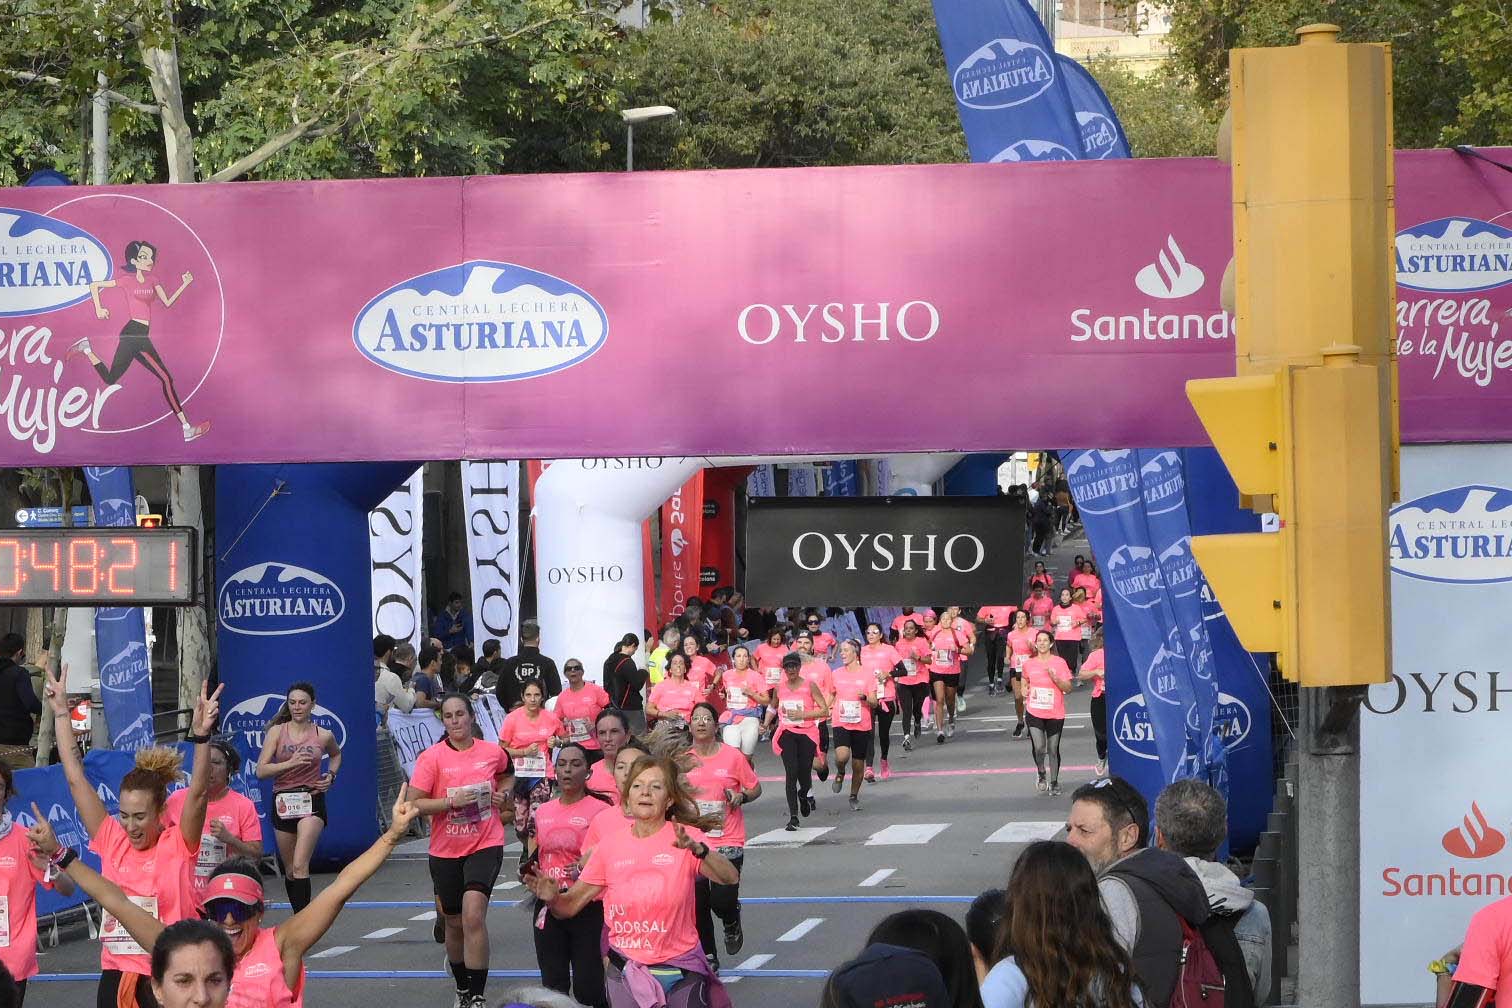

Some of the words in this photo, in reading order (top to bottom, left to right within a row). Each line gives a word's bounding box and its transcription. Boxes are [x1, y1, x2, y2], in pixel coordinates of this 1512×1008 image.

[15, 243, 87, 256] LECHERA
[1410, 242, 1460, 251] CENTRAL
[1466, 241, 1512, 250] LECHER
[412, 303, 489, 317] CENTRAL
[498, 301, 580, 314] LECHERA
[1396, 298, 1492, 328] arrera
[372, 308, 588, 353] ASTURIANA
[737, 300, 941, 345] OYSHO
[1071, 308, 1237, 342] Santand
[1419, 328, 1437, 356] la
[1433, 321, 1512, 388] Muje
[1417, 520, 1487, 531] CENTRAL
[791, 531, 985, 573] OYSHO
[548, 565, 624, 586] OYSHO
[235, 587, 277, 595] CENTRAL
[282, 586, 331, 595] LECHERA
[223, 590, 335, 619] ASTURIANA
[521, 667, 536, 677] BP
[445, 824, 478, 835] SUMA
[614, 920, 667, 933] DORSAL
